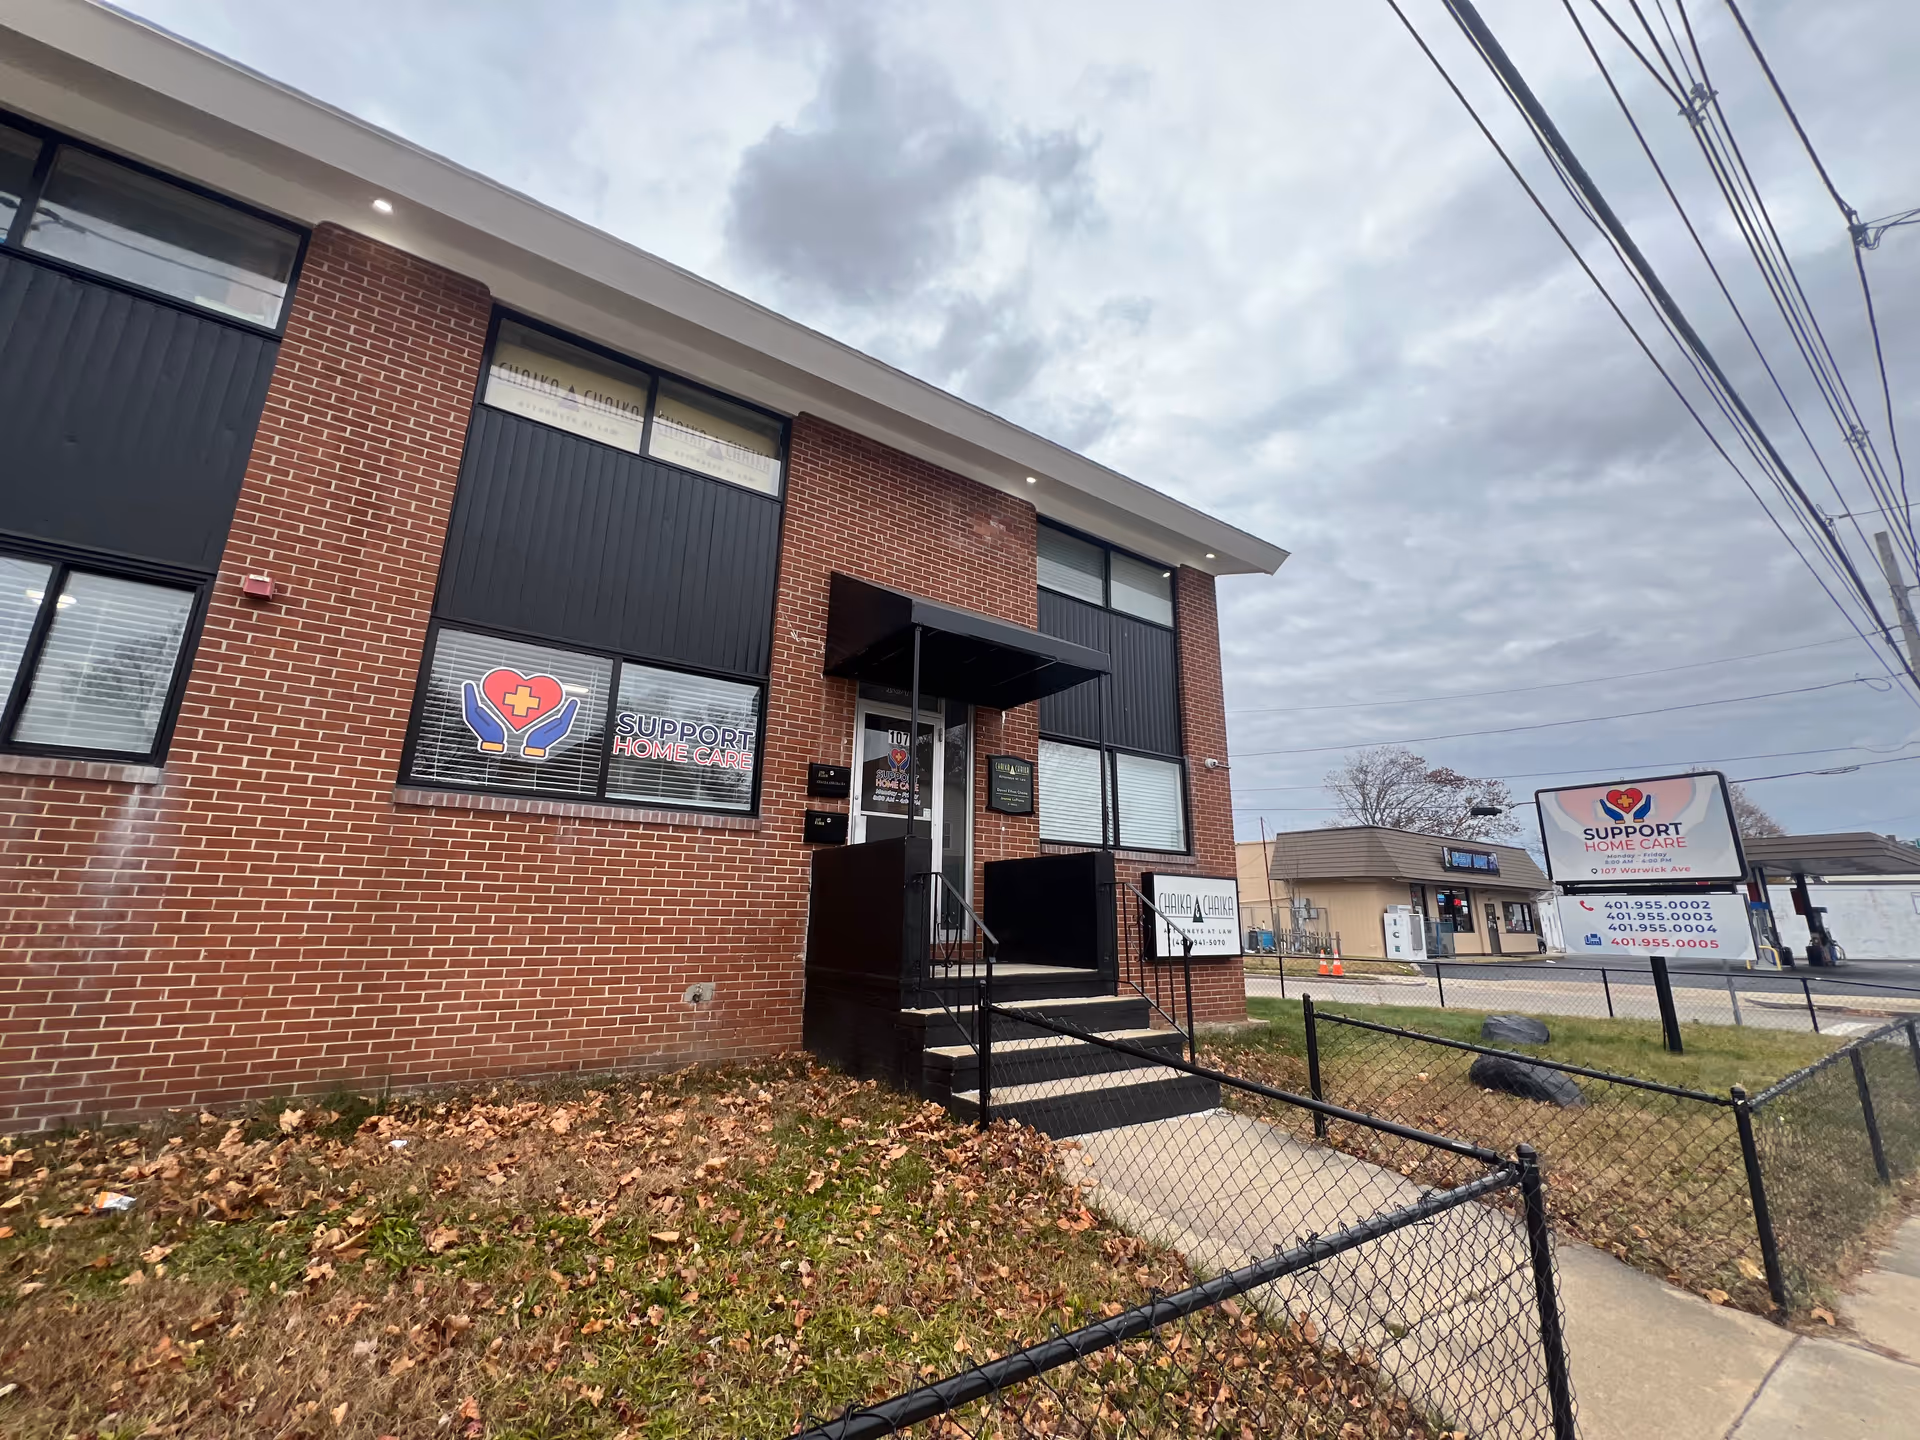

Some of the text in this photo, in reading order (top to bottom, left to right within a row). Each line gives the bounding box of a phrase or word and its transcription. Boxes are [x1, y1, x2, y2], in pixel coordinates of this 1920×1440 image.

[617, 712, 754, 750] SUPPORT
[890, 731, 909, 745] 107
[613, 736, 753, 770] HOME CARE
[876, 769, 919, 784] SUPPOT
[876, 779, 919, 792] HOME CAE
[1583, 822, 1683, 840] SUPPORT
[1584, 836, 1688, 852] HOME CARE
[1620, 866, 1667, 874] Warwick
[1159, 893, 1192, 915] CHAIKA
[1203, 895, 1234, 917] CHAIKA
[1604, 900, 1711, 909] 401.955.0002
[1606, 912, 1713, 921] 401.955.0003
[1608, 923, 1717, 933] 401.955.0004
[1611, 937, 1719, 949] 401.955.0005
